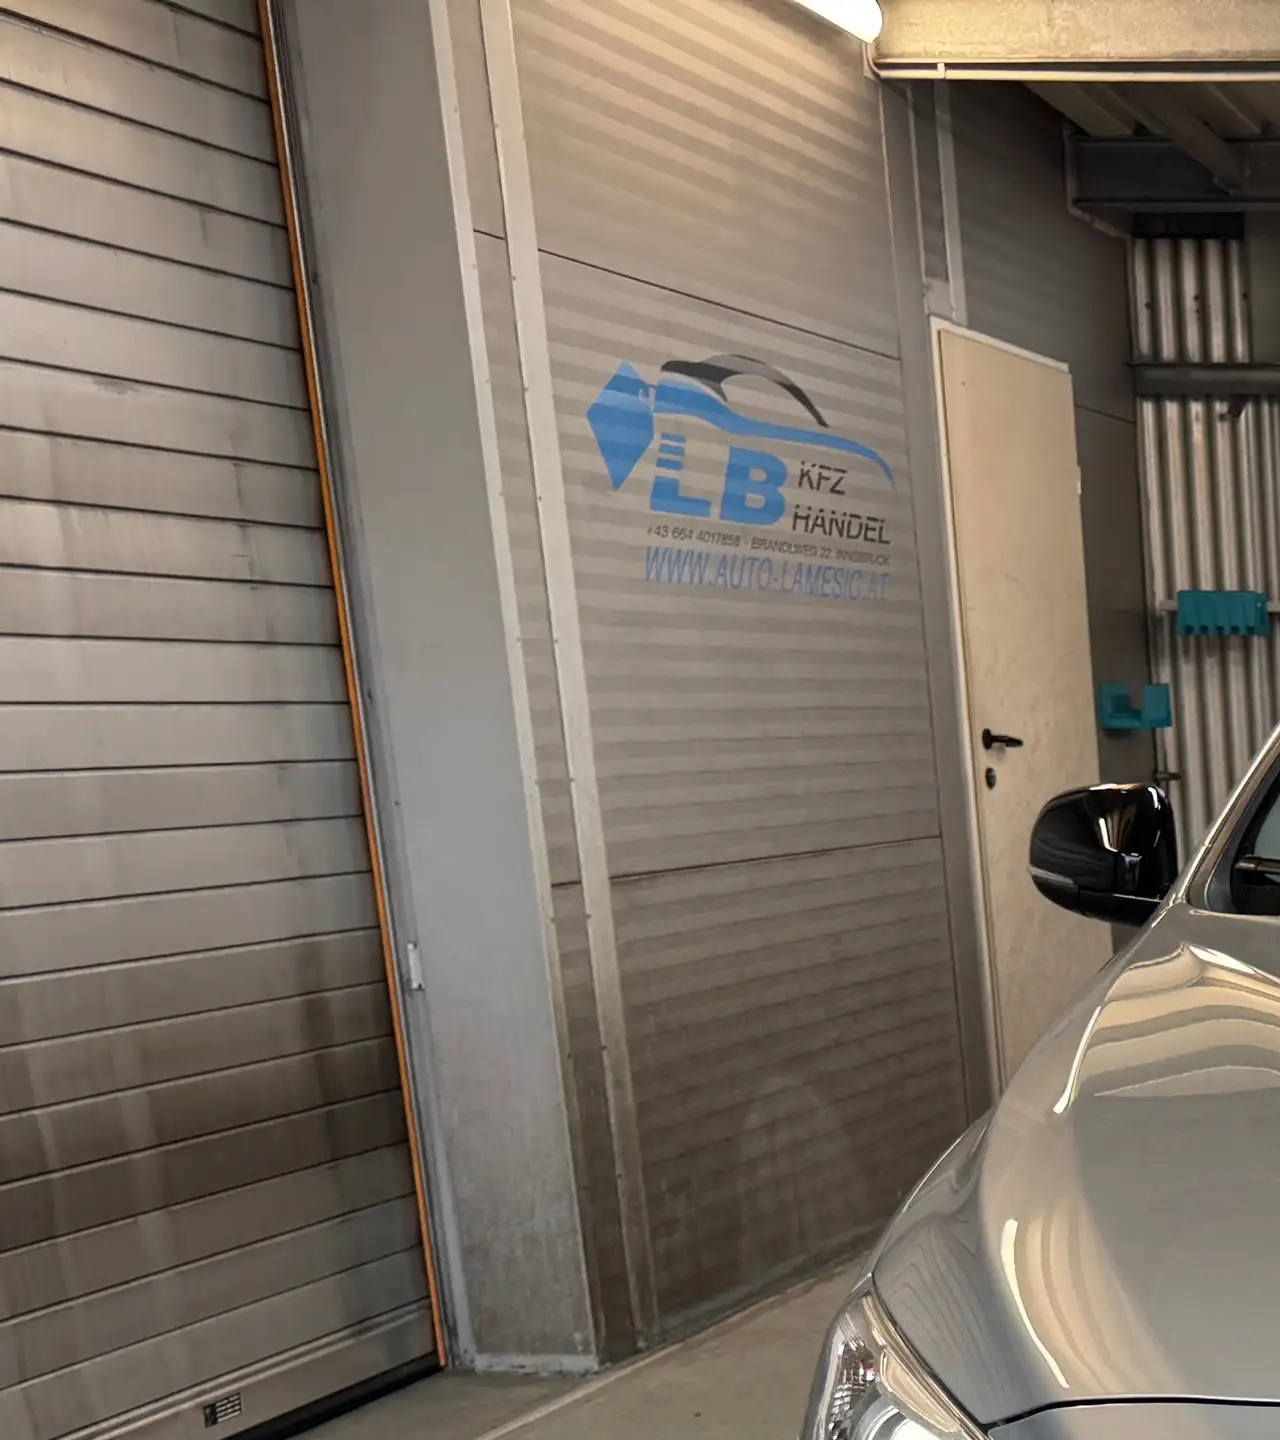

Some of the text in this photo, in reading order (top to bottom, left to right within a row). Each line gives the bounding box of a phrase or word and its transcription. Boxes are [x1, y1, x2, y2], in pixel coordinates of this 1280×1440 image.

[649, 432, 788, 526] LB
[797, 460, 848, 496] KFZ
[791, 503, 891, 546] HANDEL
